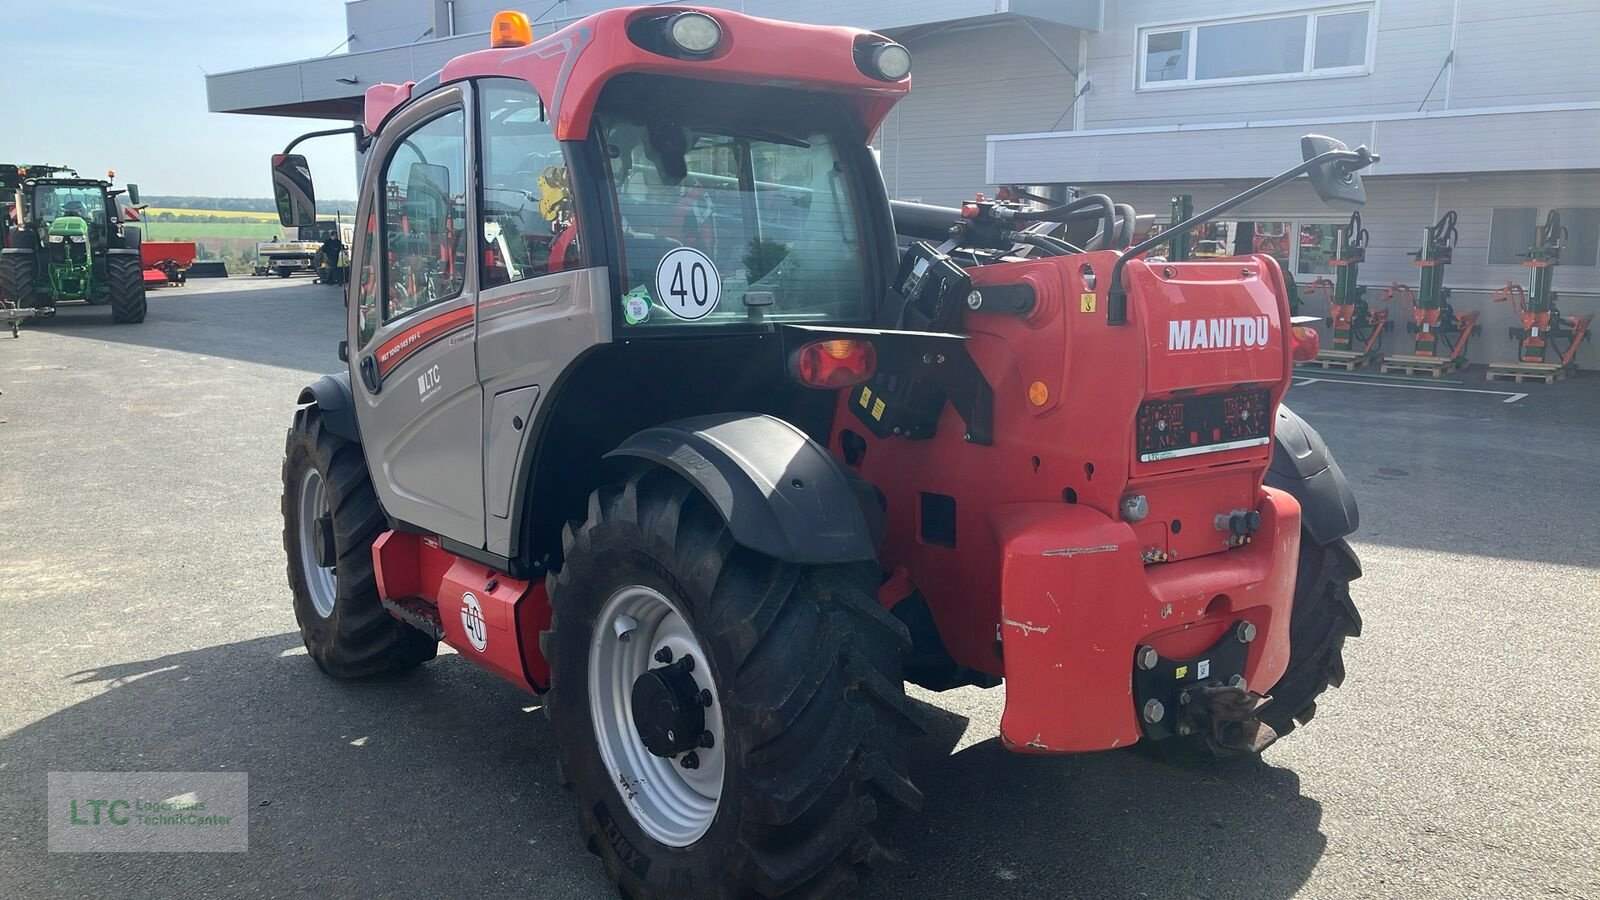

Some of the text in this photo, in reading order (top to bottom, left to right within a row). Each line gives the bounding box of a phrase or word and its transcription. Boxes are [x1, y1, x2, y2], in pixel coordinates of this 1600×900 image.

[670, 261, 708, 307] 40
[1168, 315, 1269, 351] MANITOU
[424, 364, 440, 390] LTC
[1147, 453, 1161, 461] LTC
[466, 605, 483, 642] 40
